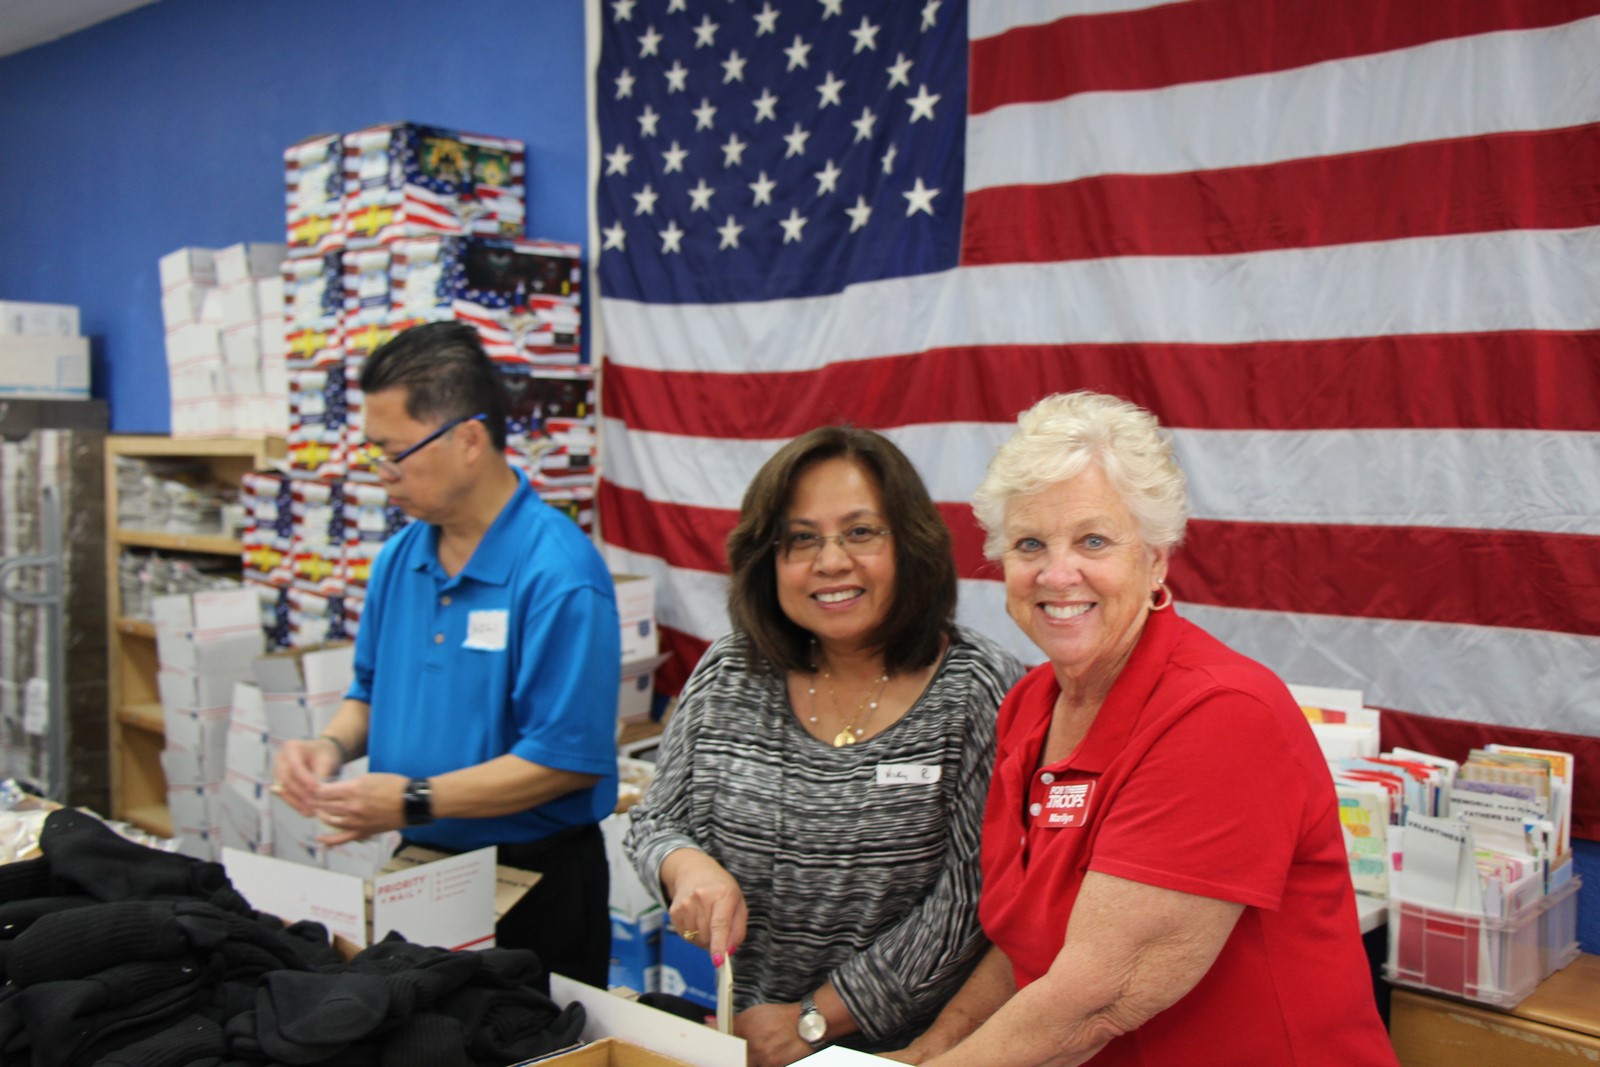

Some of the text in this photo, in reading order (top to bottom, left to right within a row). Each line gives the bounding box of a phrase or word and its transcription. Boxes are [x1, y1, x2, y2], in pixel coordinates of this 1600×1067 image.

[1046, 794, 1086, 809] TROOPS
[1463, 810, 1502, 821] FATHERS
[377, 874, 428, 895] PRIORITY
[389, 892, 415, 903] MAIL
